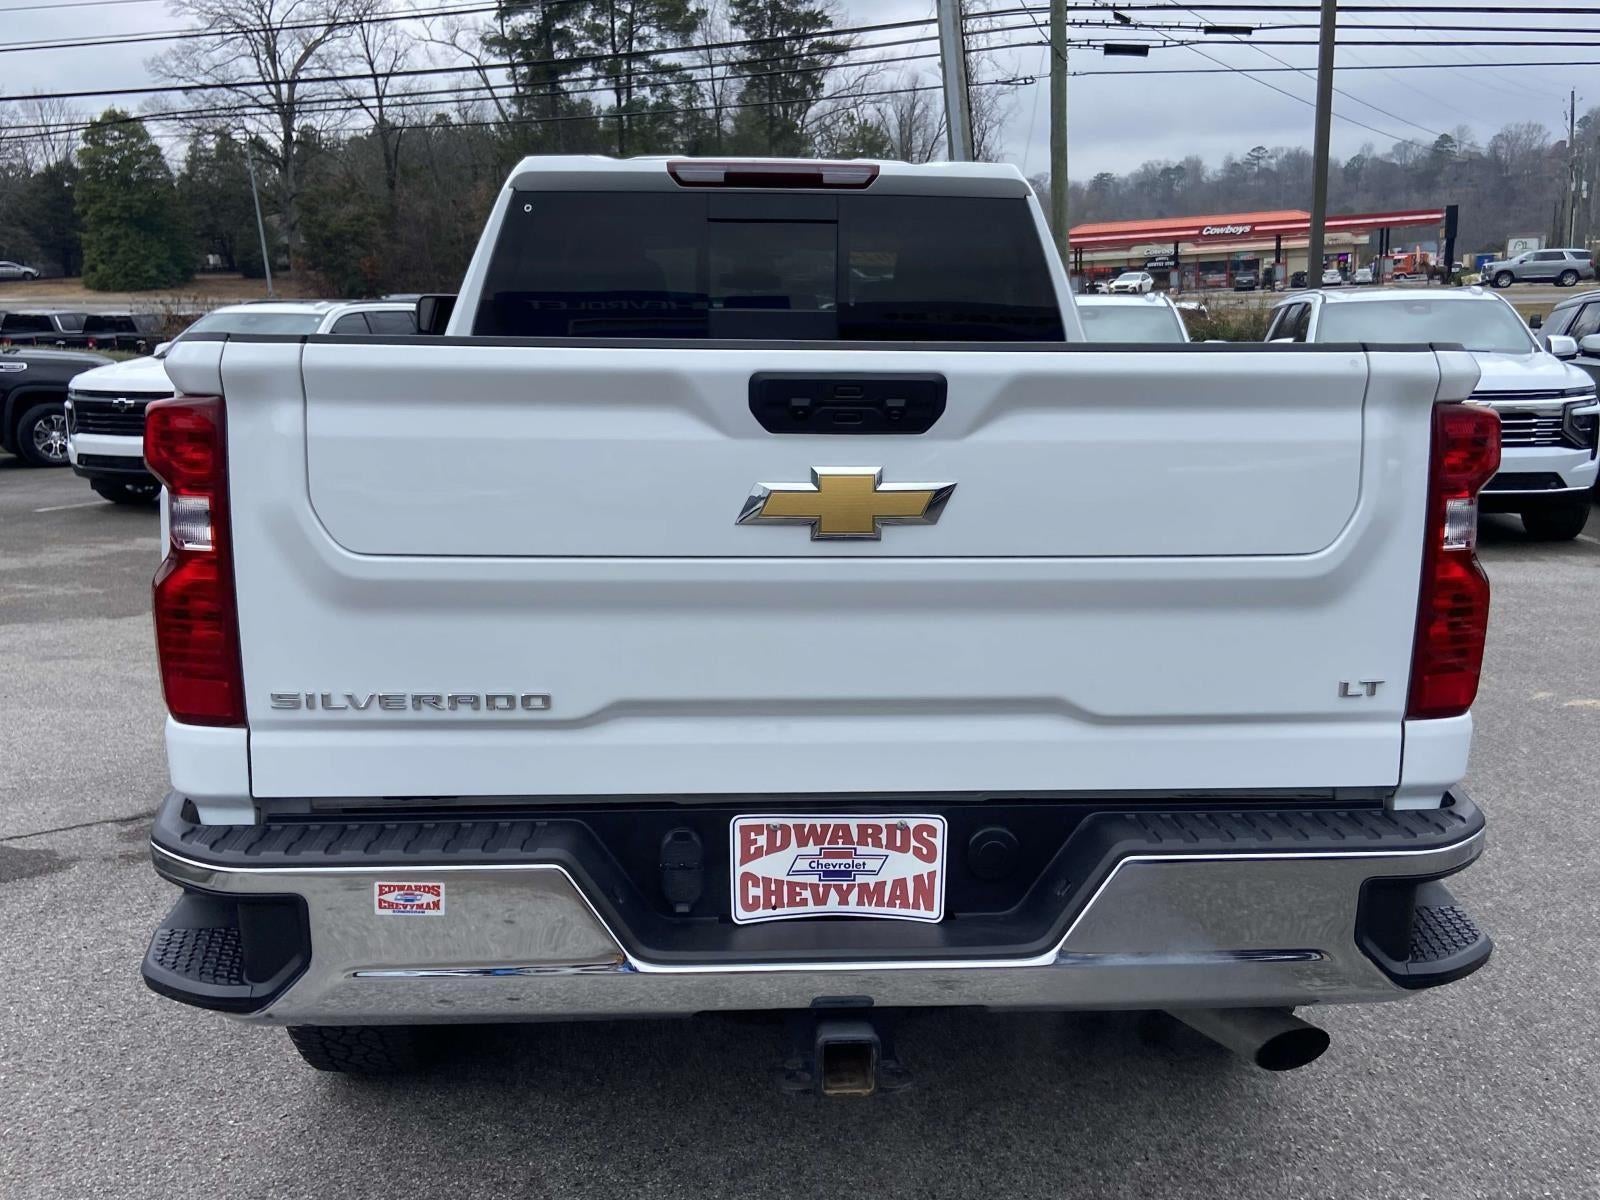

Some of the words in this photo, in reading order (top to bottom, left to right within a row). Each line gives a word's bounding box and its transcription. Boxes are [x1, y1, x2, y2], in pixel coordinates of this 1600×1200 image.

[1202, 224, 1251, 235] Cowboys
[1338, 679, 1386, 698] LT
[270, 692, 552, 711] SILVERADO
[739, 823, 938, 867] EDWARDS
[808, 859, 867, 870] Chevrolet
[378, 884, 441, 897] EDWARDS
[739, 870, 937, 912] CHEVYMAN
[378, 898, 441, 910] CHEVYMAN
